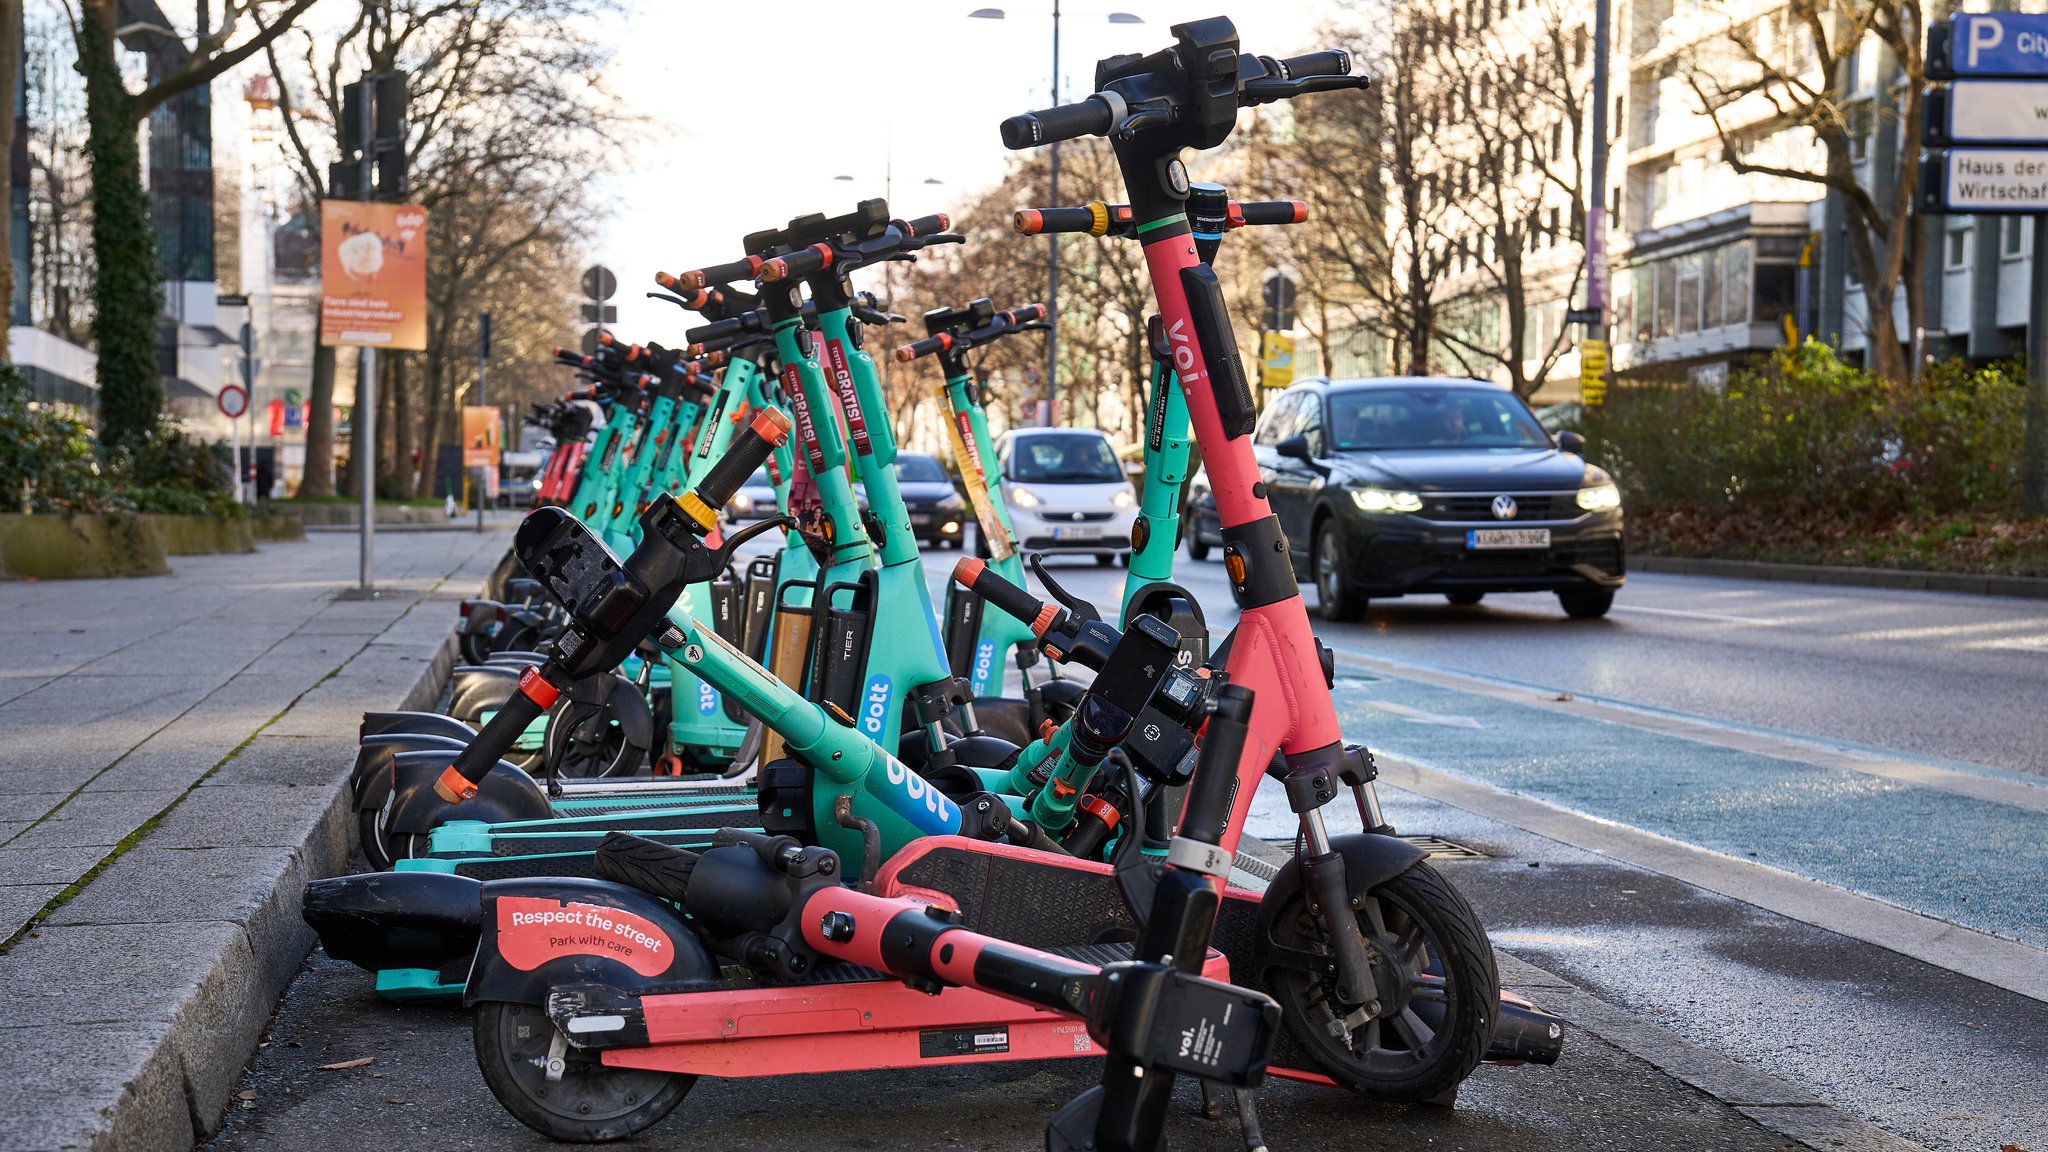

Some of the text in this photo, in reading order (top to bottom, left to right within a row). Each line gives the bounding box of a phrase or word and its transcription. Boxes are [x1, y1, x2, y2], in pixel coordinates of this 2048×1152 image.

[1968, 17, 2004, 68] P
[1957, 158, 2046, 176] Haus der
[836, 369, 862, 422] GRATIS!
[793, 392, 817, 443] GRATIS!
[721, 597, 729, 621] TIER
[843, 629, 854, 661] TIER
[976, 644, 993, 680] dott
[701, 682, 715, 710] ott
[865, 683, 889, 733] dott
[512, 911, 662, 953] Respect the street
[550, 935, 633, 956] Park with care
[1179, 1027, 1195, 1057] voi.
